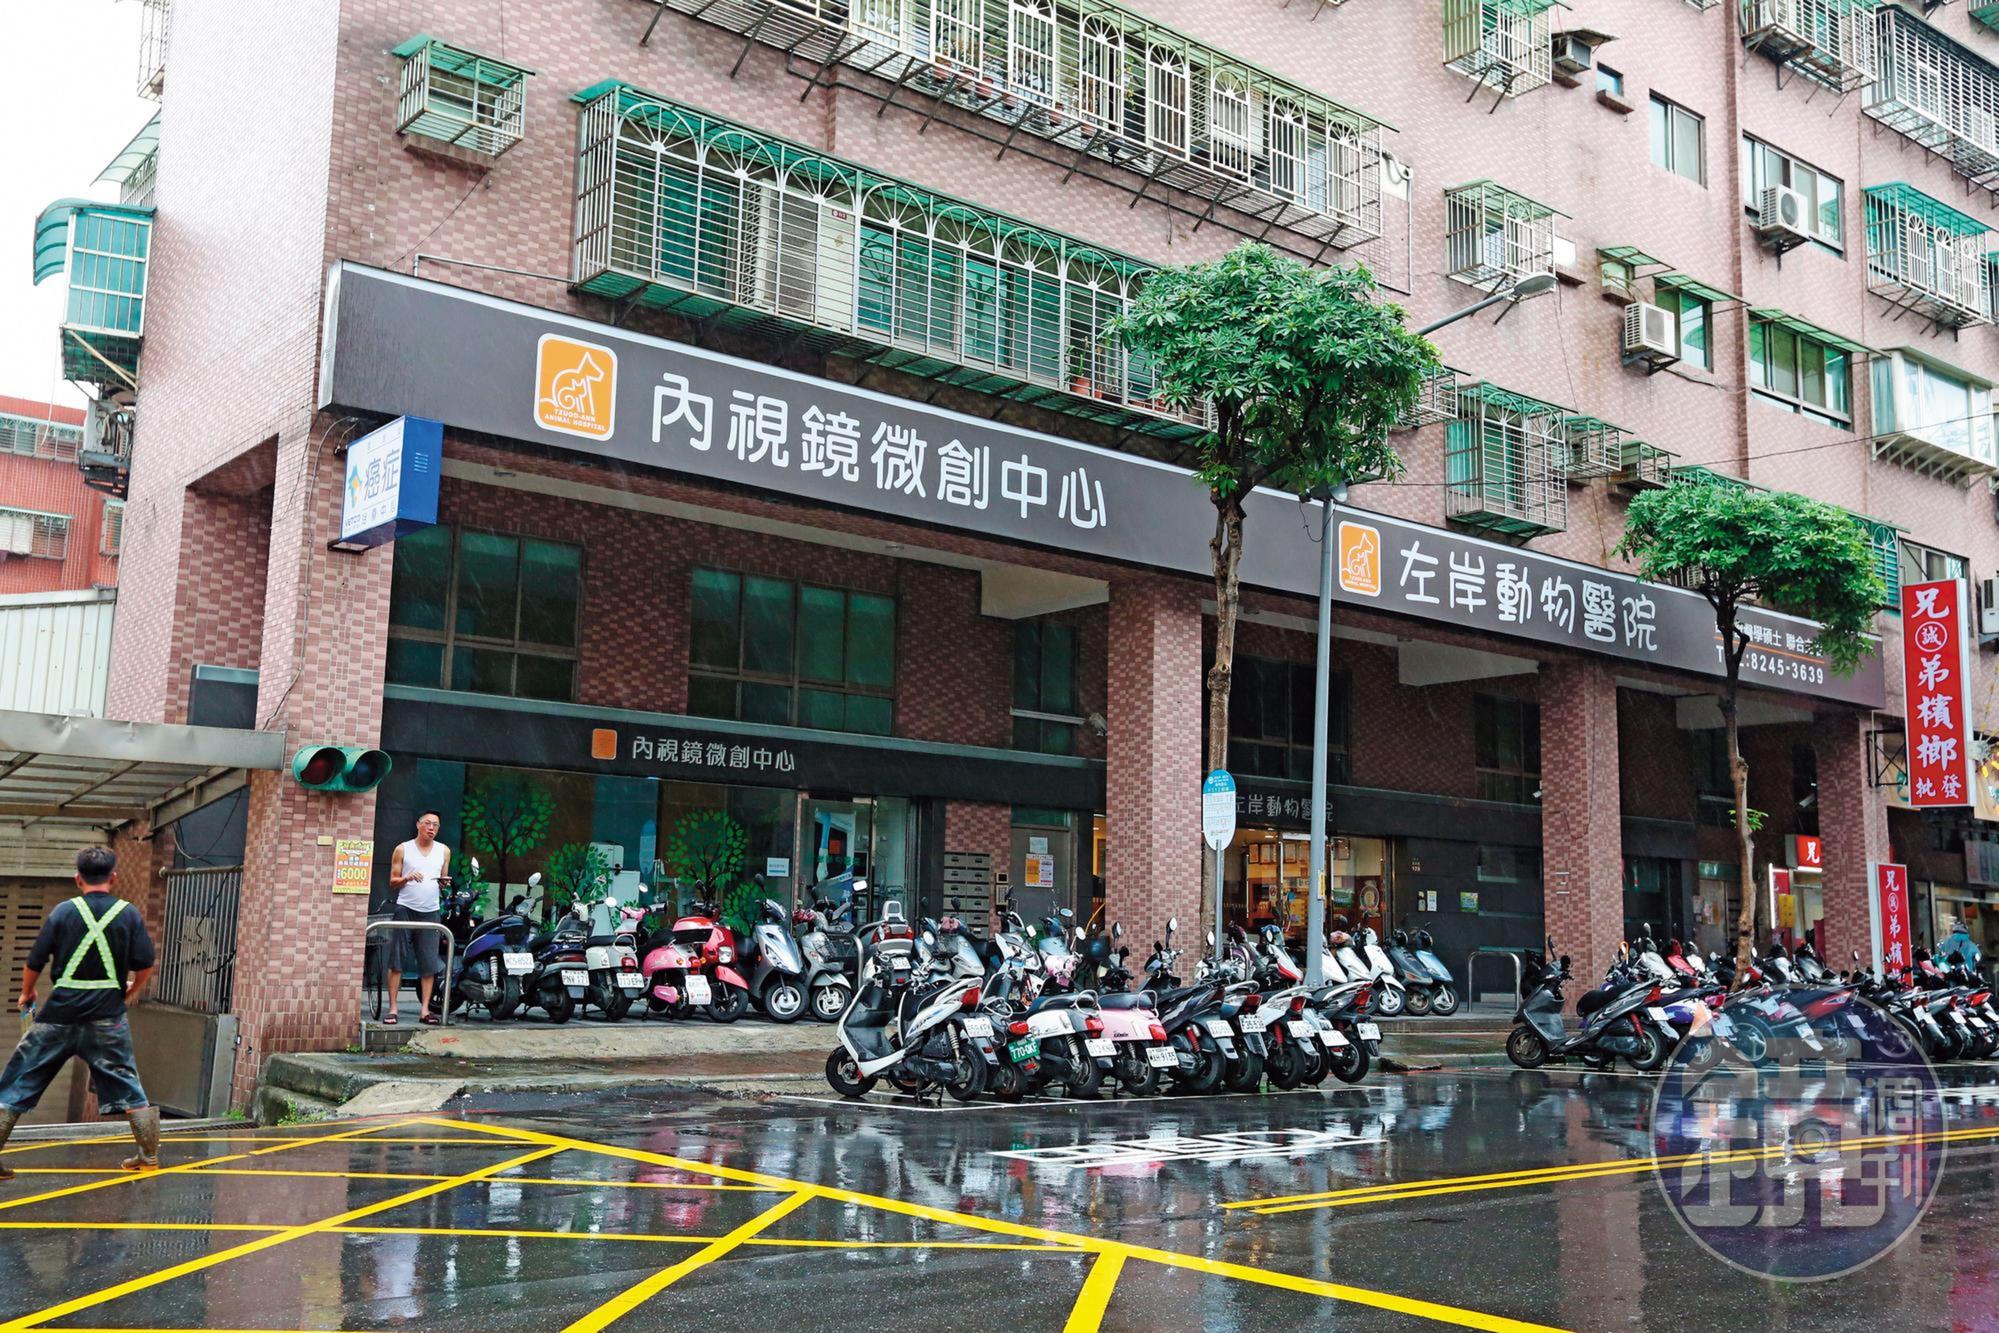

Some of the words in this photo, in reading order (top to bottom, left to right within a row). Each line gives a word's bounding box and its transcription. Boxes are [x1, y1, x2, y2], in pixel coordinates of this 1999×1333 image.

[545, 413, 571, 425] ANIMAL
[573, 419, 606, 432] HOSPITAL
[651, 372, 1107, 529] 內視鏡微創中心
[364, 448, 400, 501] 癌症
[1400, 540, 1657, 651] 左岸動物醫院
[1716, 645, 1824, 684] T:8245-3639
[632, 736, 795, 772] 內視鏡微創中心
[1916, 775, 1962, 799] 批發
[1807, 841, 1820, 864] 兄
[340, 867, 367, 881] 6000
